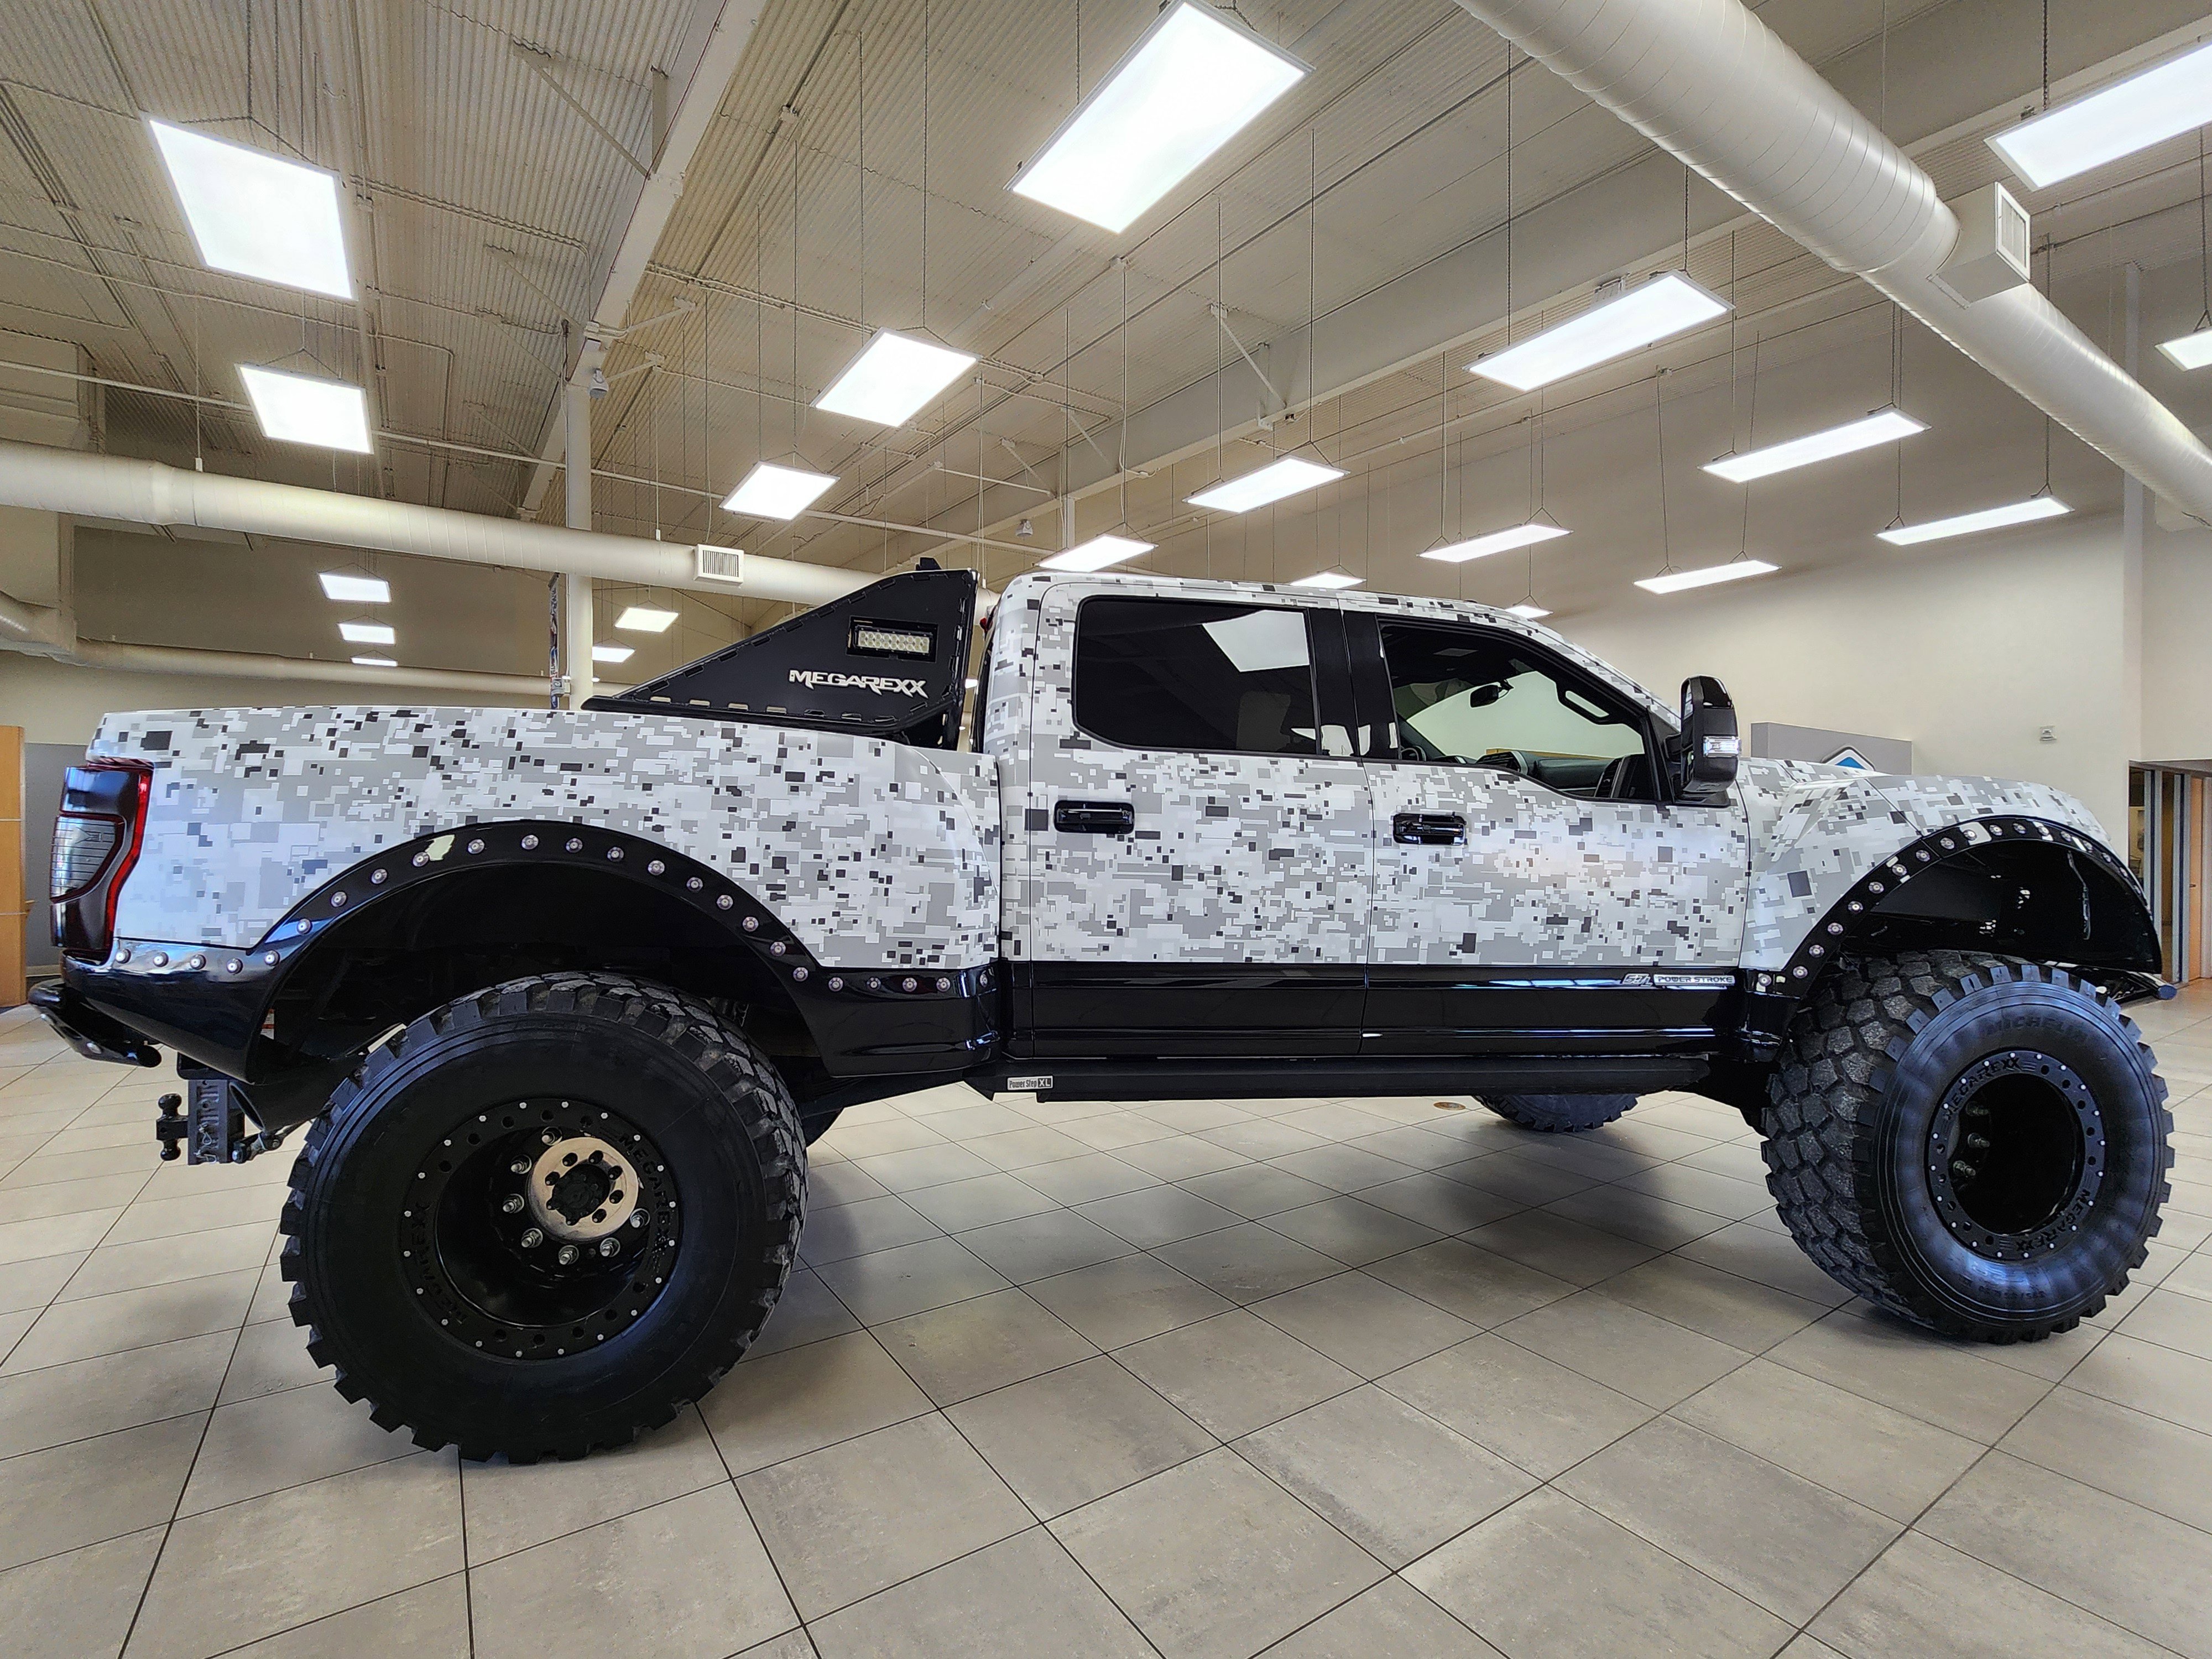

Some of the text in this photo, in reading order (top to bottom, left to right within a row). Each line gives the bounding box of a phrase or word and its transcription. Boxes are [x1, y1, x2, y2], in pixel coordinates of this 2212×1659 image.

[789, 670, 929, 699] MEGAREXX
[1009, 1078, 1051, 1088] Power Step XL
[1943, 1057, 2022, 1120] MEGAREXX
[619, 1135, 670, 1254] MEGAREXX
